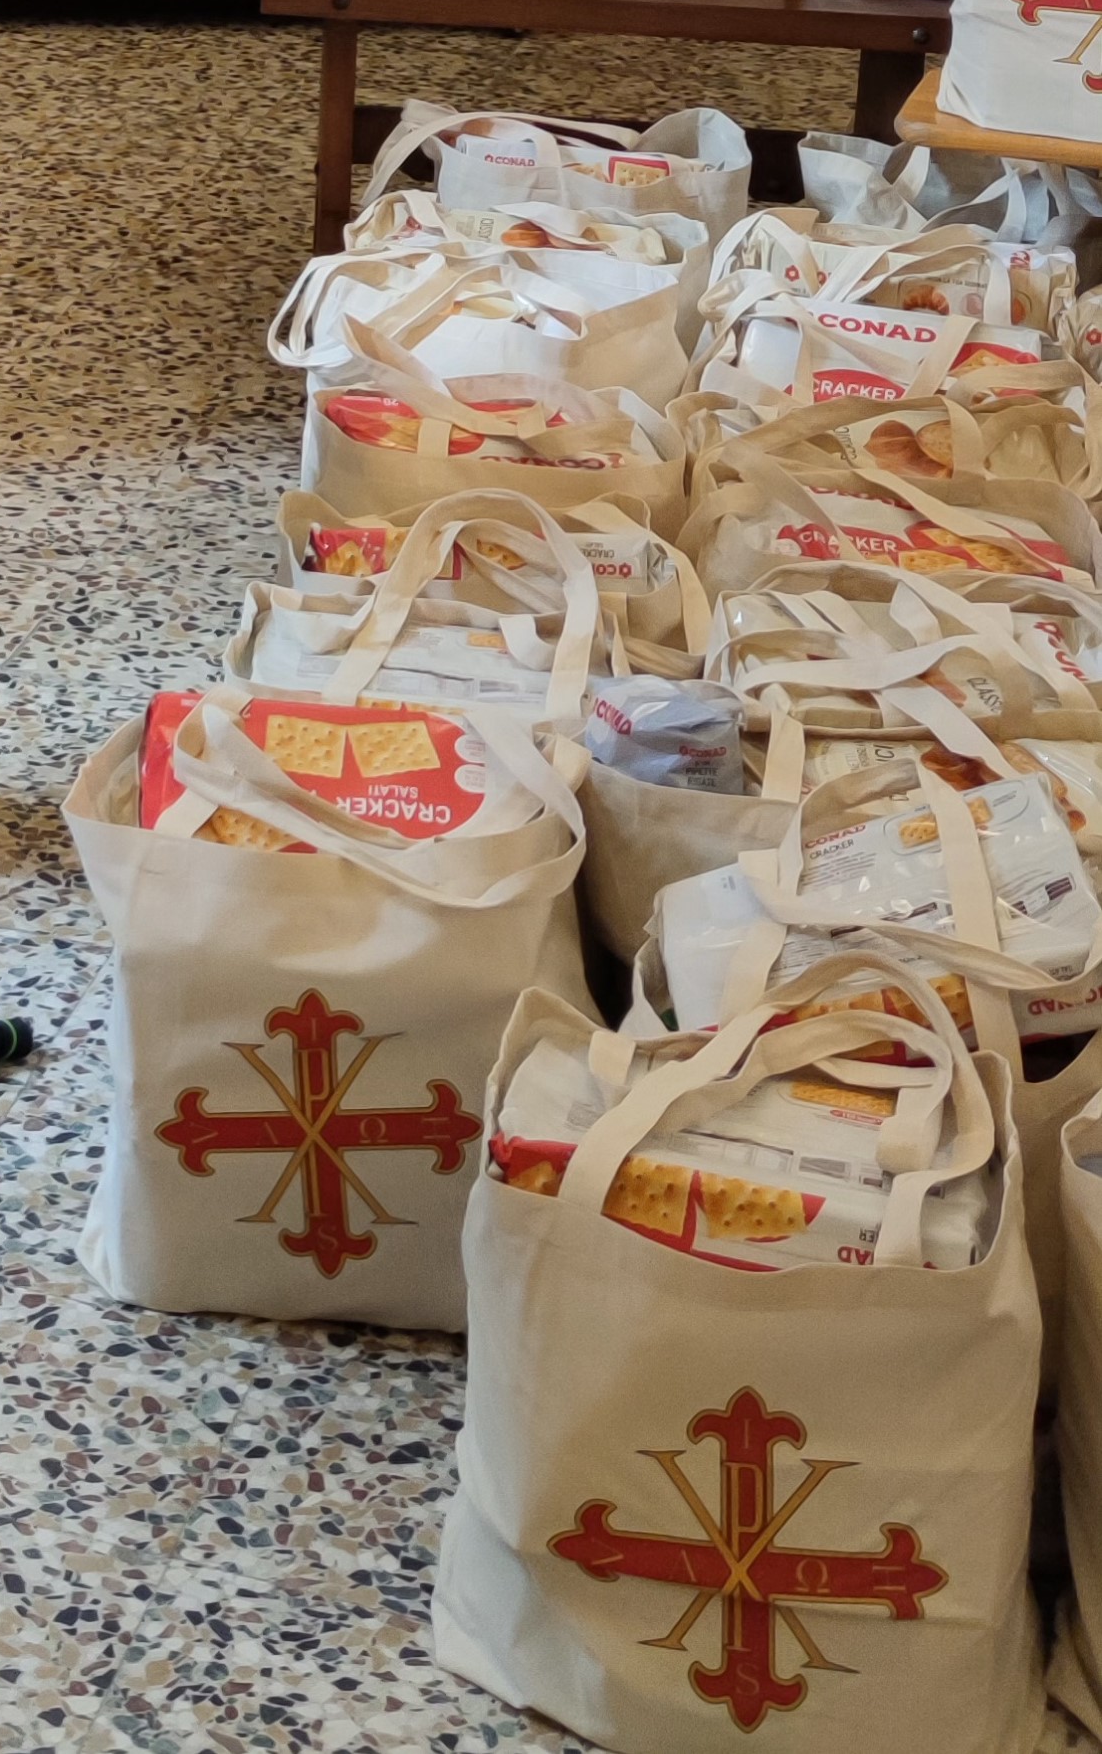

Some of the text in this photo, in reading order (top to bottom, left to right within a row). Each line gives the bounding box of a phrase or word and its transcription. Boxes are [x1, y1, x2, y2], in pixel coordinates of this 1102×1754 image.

[494, 156, 536, 167] CONAD
[817, 313, 937, 344] CONAD
[798, 530, 897, 552] CRAKER
[688, 747, 727, 757] CONAD
[368, 784, 419, 799] SALATI
[336, 797, 452, 825] CRACKER
[804, 824, 867, 849] CONAD
[809, 838, 855, 860] CRACKER
